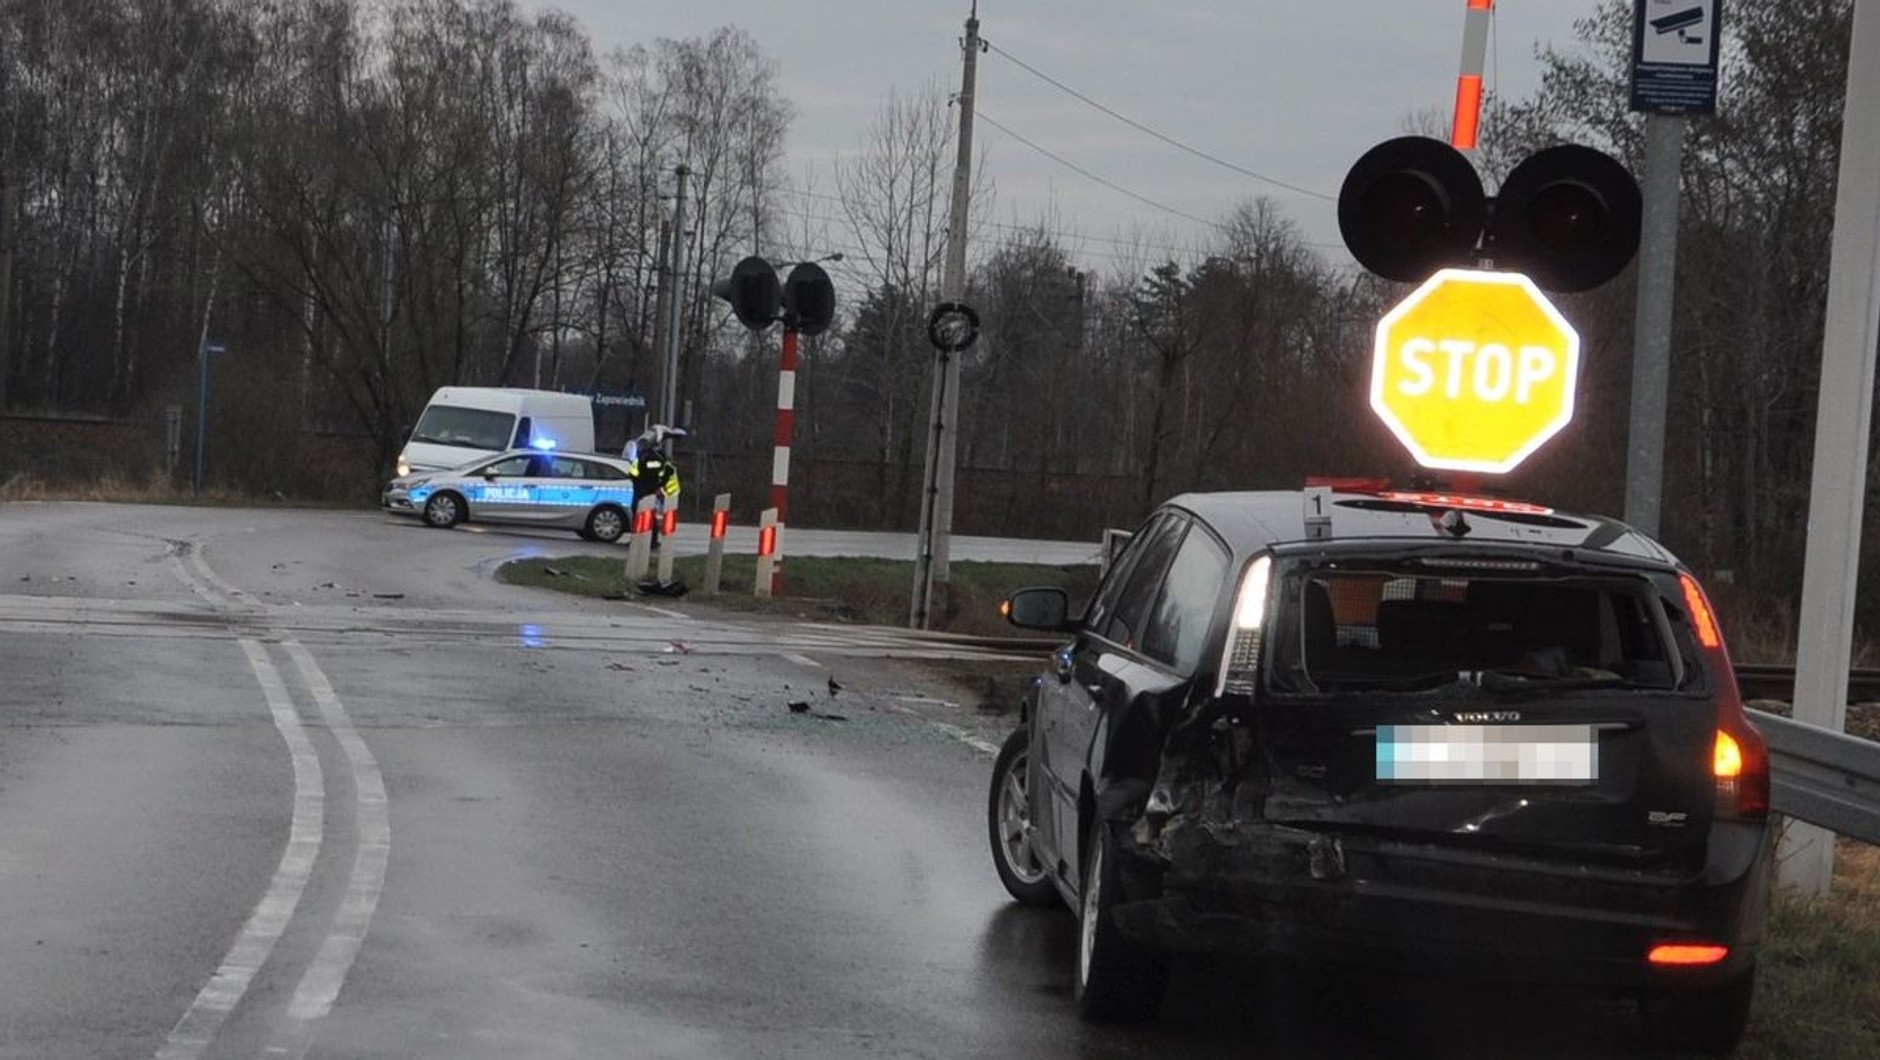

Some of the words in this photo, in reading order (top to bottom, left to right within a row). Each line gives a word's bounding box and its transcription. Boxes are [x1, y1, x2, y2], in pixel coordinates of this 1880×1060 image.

[1398, 338, 1556, 405] STOP
[485, 486, 530, 500] POLICJA
[1311, 494, 1323, 515] 1
[1454, 710, 1521, 722] VOLVO
